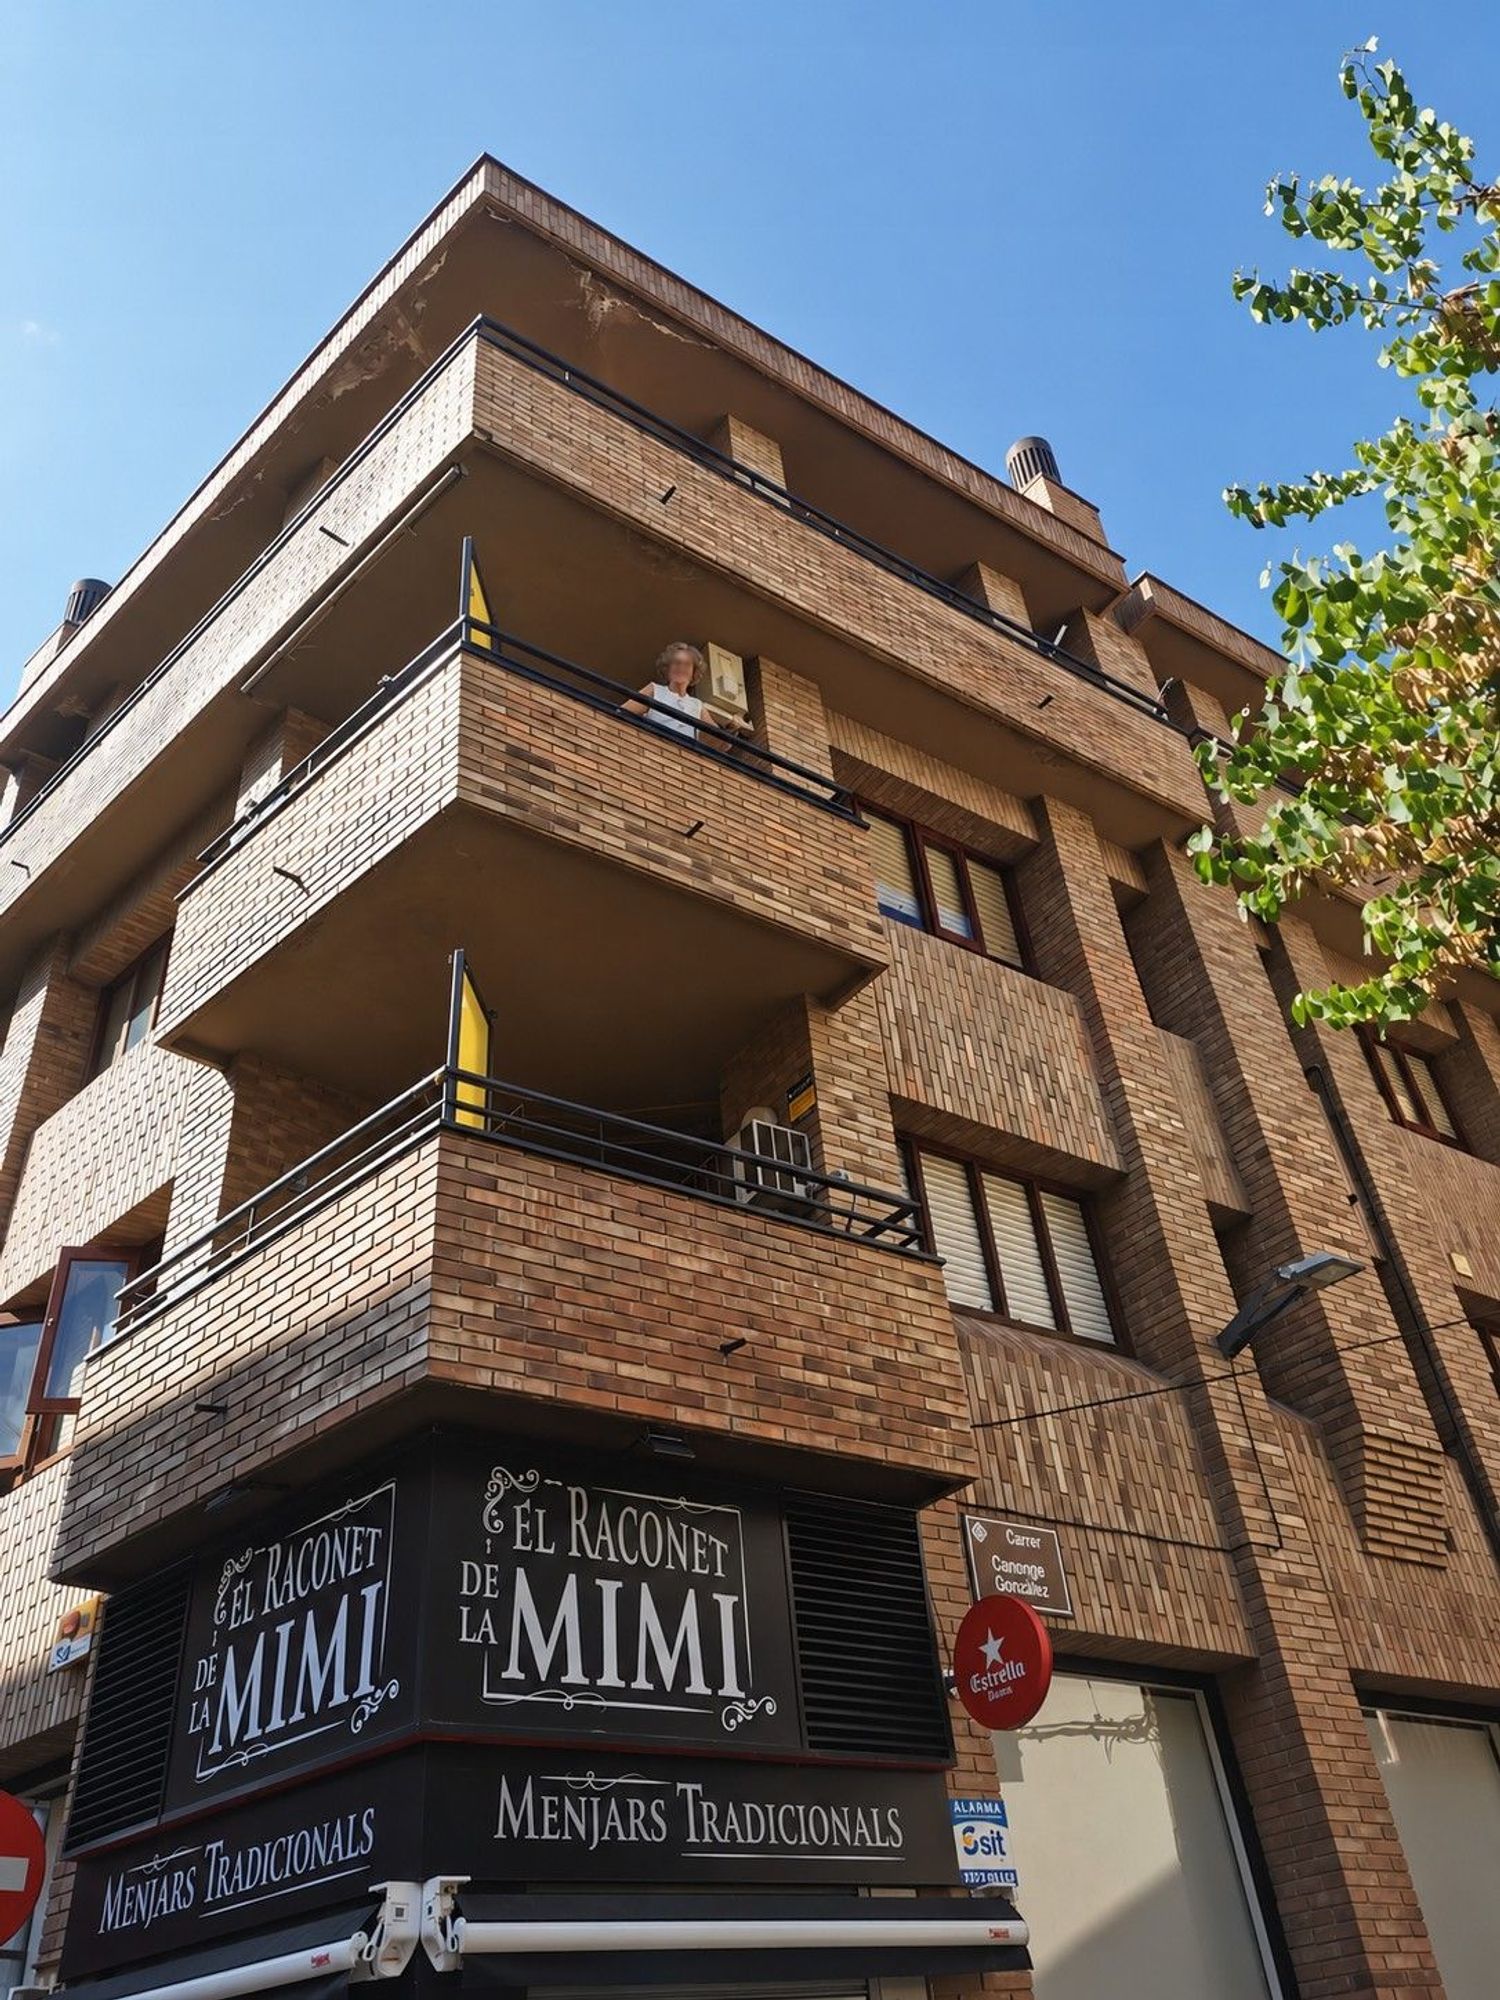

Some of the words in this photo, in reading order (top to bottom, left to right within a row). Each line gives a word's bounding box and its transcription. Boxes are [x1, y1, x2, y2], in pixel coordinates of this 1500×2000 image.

[567, 1486, 729, 1578] RACONET
[1006, 1528, 1041, 1549] Carrer
[261, 1526, 382, 1616] RACONET
[461, 1560, 499, 1598] DE
[992, 1554, 1045, 1581] Canonge
[459, 1606, 498, 1644] LA
[501, 1567, 746, 1698] MIMI
[193, 1653, 218, 1692] DE
[208, 1580, 383, 1755] MIMI
[970, 1660, 1026, 1693] Estrella
[188, 1697, 210, 1734] LA
[494, 1774, 667, 1849] MENJARS
[676, 1782, 904, 1848] TRADICIONALS
[954, 1801, 1002, 1813] ALARMA
[98, 1866, 196, 1934] MENJARS
[204, 1808, 374, 1903] TRADICIONALS
